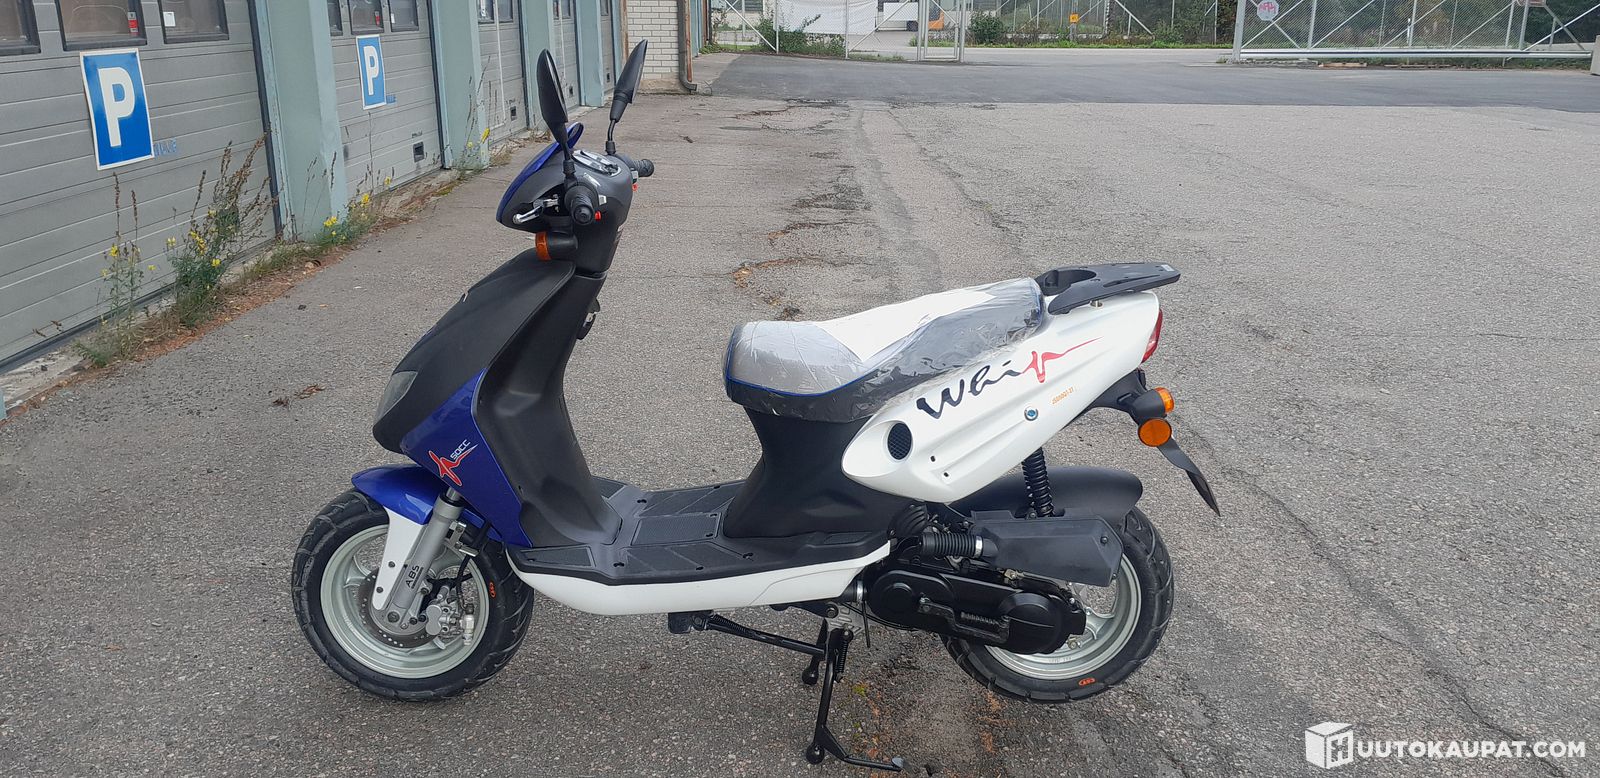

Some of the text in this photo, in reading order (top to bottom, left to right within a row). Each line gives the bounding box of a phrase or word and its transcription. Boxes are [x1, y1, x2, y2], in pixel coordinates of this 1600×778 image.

[363, 45, 379, 95] P
[97, 66, 135, 147] P
[405, 565, 420, 588] ABS
